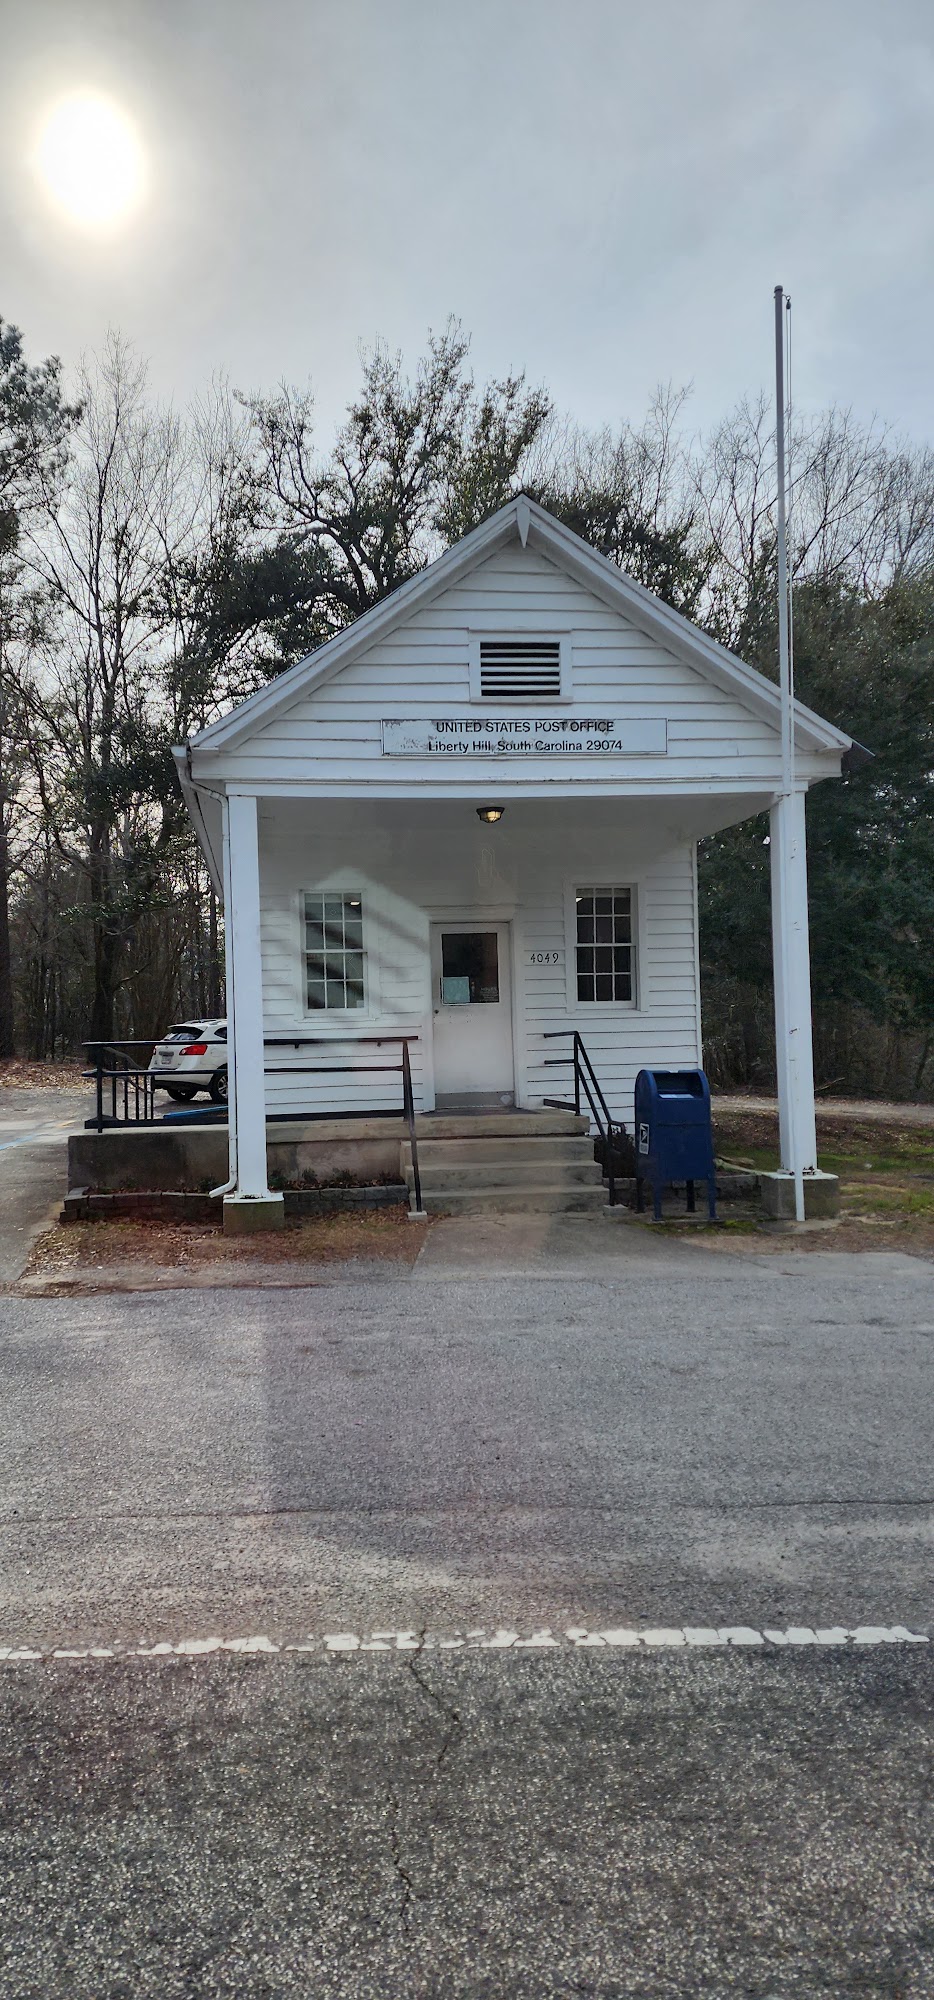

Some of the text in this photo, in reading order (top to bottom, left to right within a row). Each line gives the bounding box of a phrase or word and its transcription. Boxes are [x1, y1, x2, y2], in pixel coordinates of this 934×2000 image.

[436, 721, 614, 733] UNITED STATES POST OFFICE
[428, 741, 469, 754] Liberty
[497, 740, 531, 751] South
[535, 740, 582, 751] Carolina
[586, 740, 623, 751] 29074
[530, 952, 559, 964] 4049
